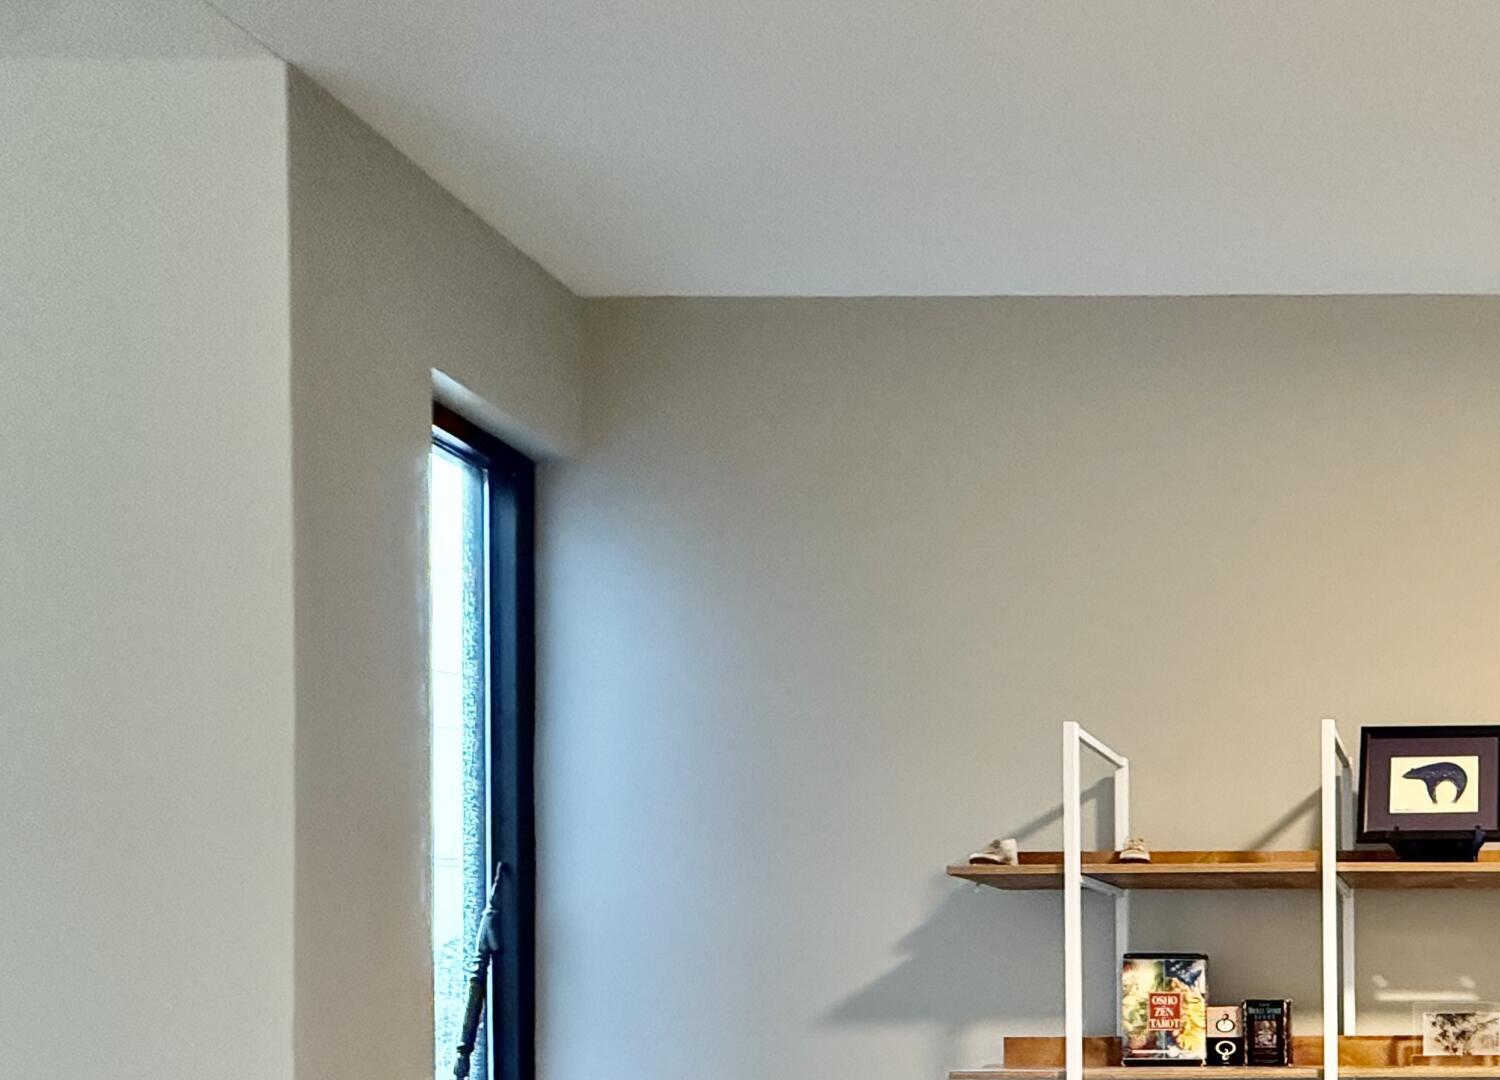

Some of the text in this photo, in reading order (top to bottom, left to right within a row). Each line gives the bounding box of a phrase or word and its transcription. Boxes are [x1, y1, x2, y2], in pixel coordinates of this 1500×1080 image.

[1151, 995, 1179, 1006] OSHO
[1153, 1006, 1175, 1017] ZEN
[1150, 1018, 1180, 1028] TAROT
